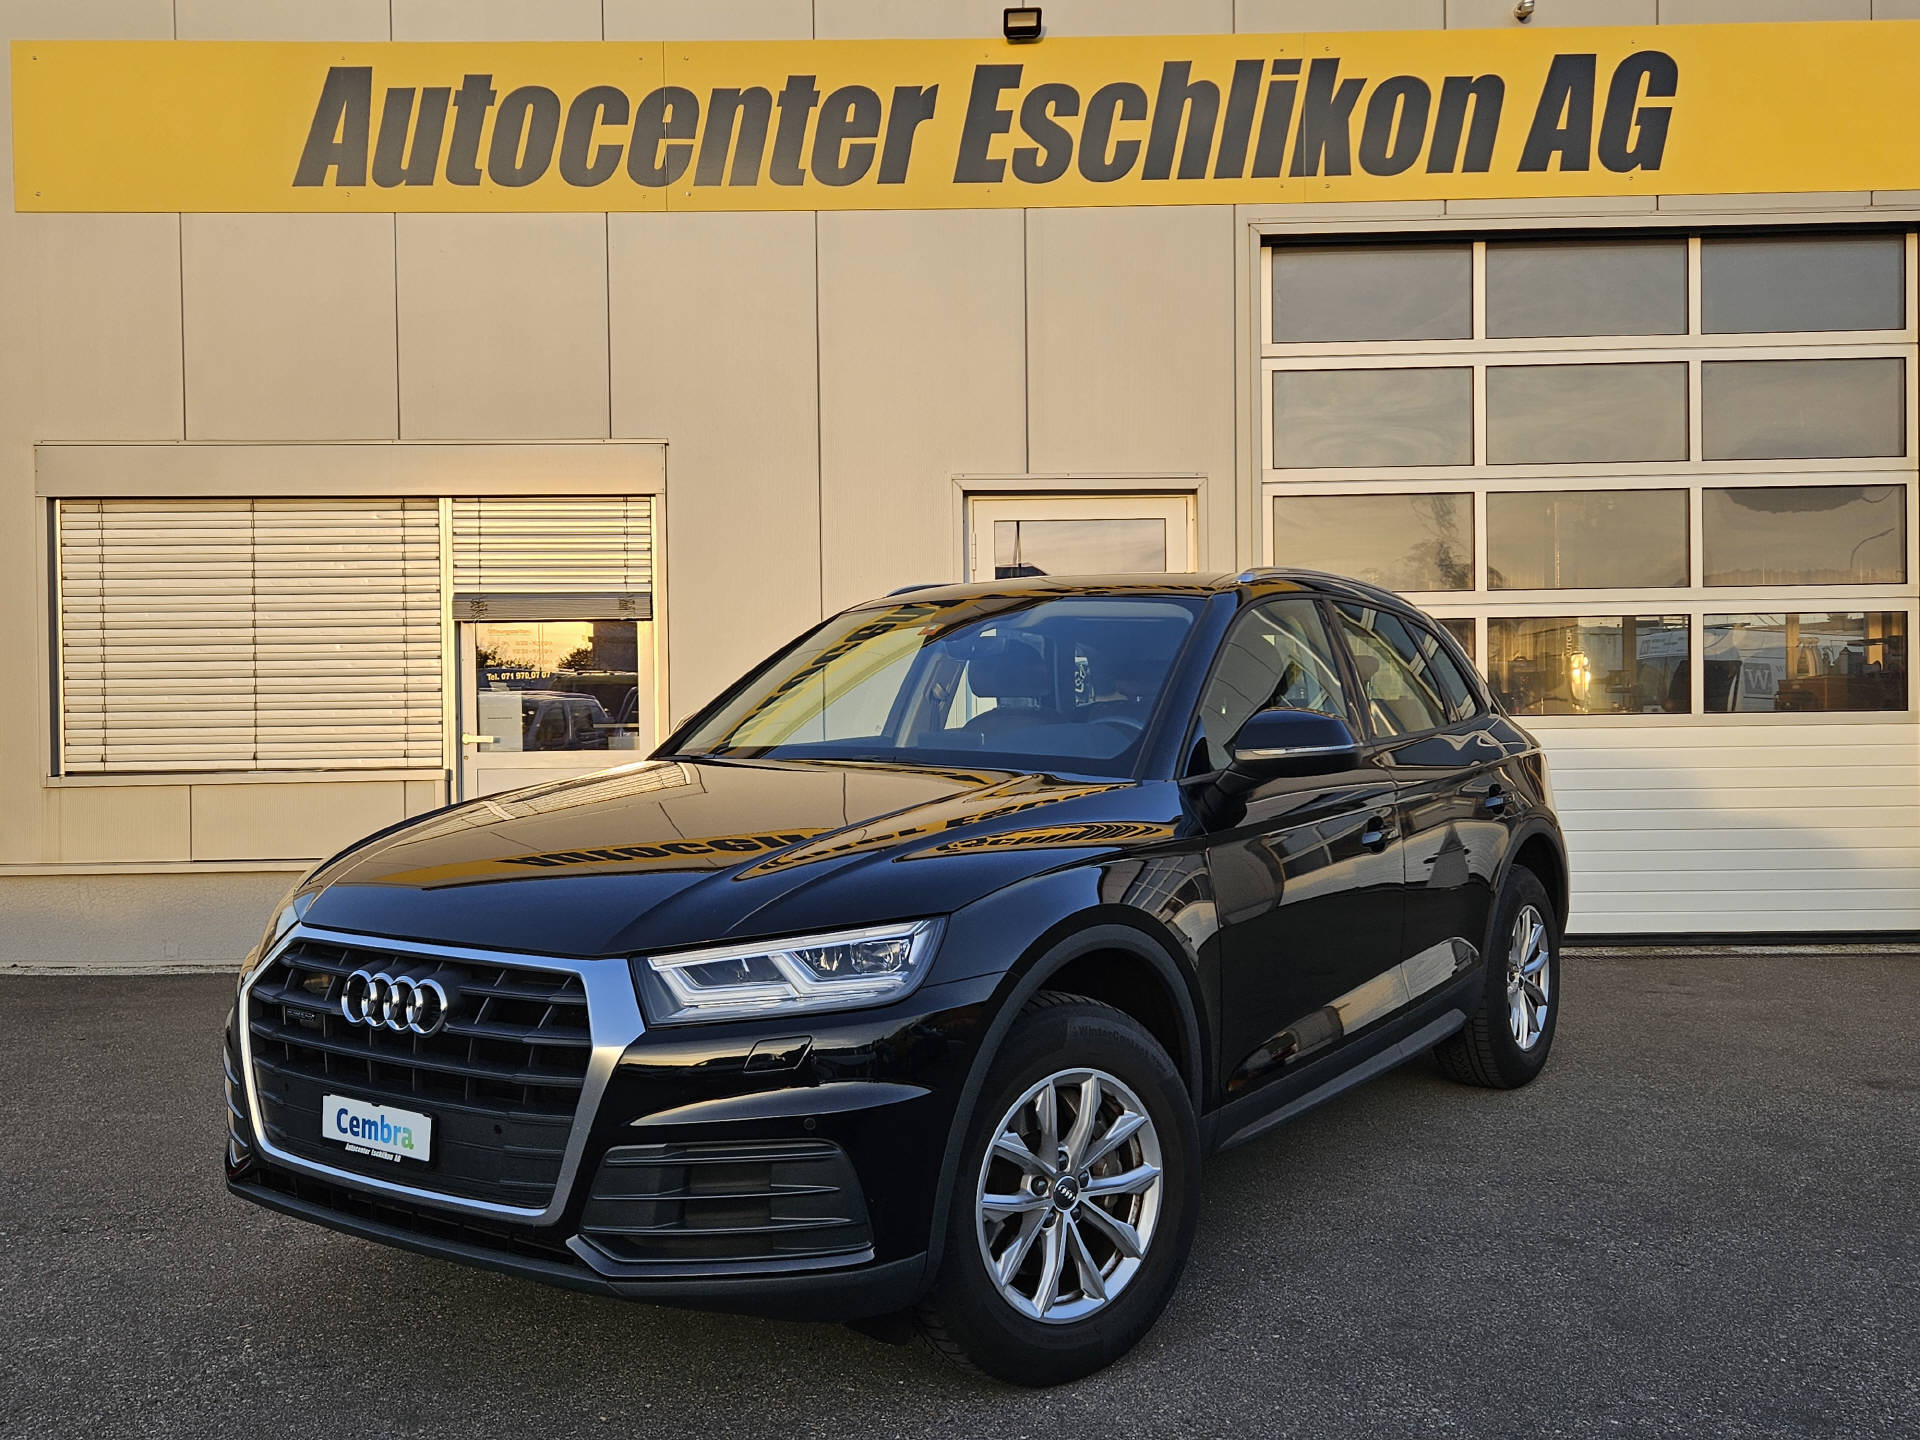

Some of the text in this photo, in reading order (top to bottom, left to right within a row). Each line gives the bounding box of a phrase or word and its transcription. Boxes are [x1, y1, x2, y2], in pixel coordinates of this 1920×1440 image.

[292, 49, 1680, 189] Autocenter Eschlikon AG
[486, 671, 552, 681] Tel. 071 970 07 07
[336, 1107, 414, 1150] Cembra
[345, 1143, 371, 1155] Autocenter
[393, 1154, 402, 1163] AG
